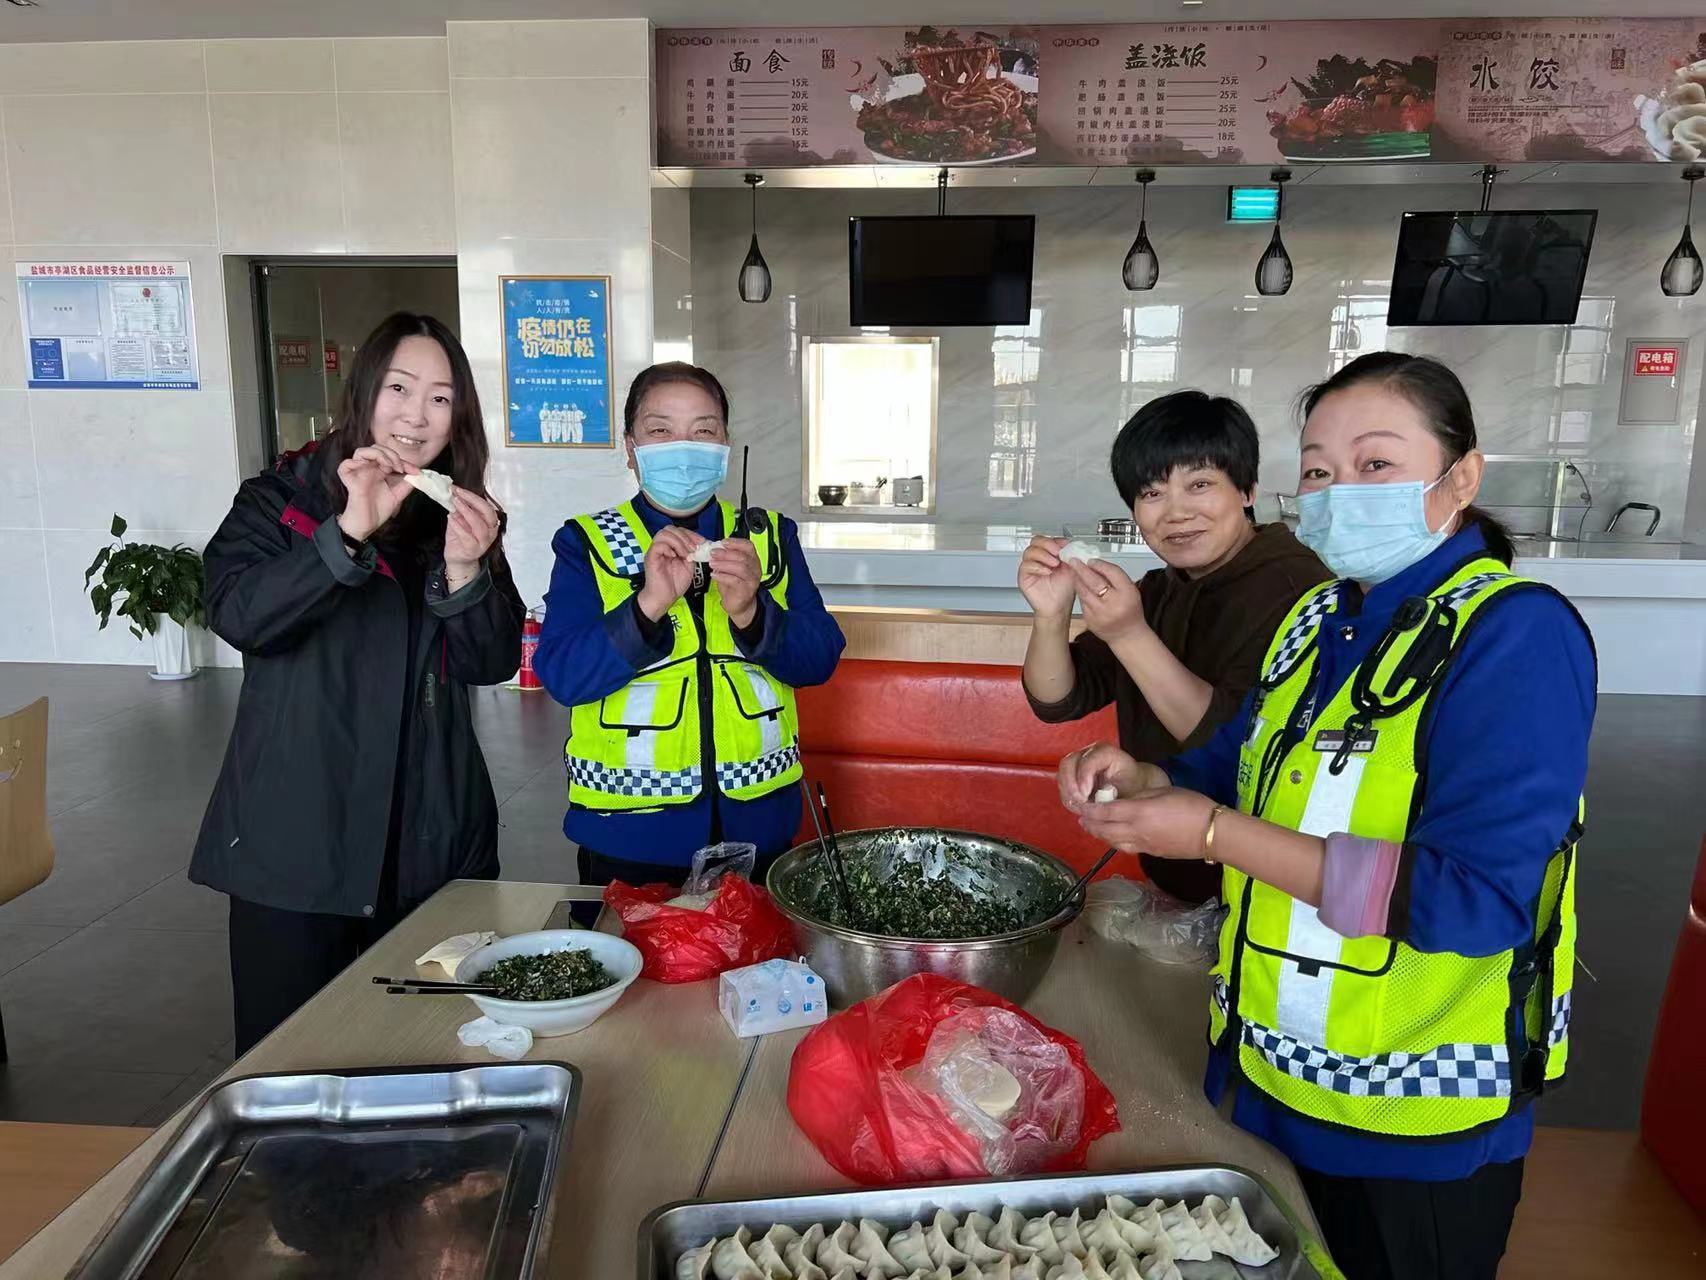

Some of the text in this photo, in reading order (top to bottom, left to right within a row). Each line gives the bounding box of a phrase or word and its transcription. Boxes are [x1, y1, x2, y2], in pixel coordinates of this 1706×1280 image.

[729, 48, 791, 74] 面食
[1125, 43, 1208, 70] 盖浇饭
[1469, 56, 1561, 91] 水饺
[791, 78, 809, 87] 15元
[1079, 76, 1239, 89] 牛肉盖浇饭 25元
[791, 90, 809, 100] 20元
[1219, 90, 1238, 100] 25元
[791, 103, 809, 112] 20元
[1218, 104, 1237, 113] 25元
[791, 115, 809, 124] 20元
[1217, 118, 1237, 128] 20元
[791, 128, 809, 137] 15元
[1217, 131, 1236, 141] 18元
[30, 265, 176, 276] 盐城市亭湖区食品经营安全监督信息公示
[517, 317, 592, 340] 疫情仍在
[522, 337, 596, 359] 切勿放松
[1639, 352, 1674, 364] 配电箱
